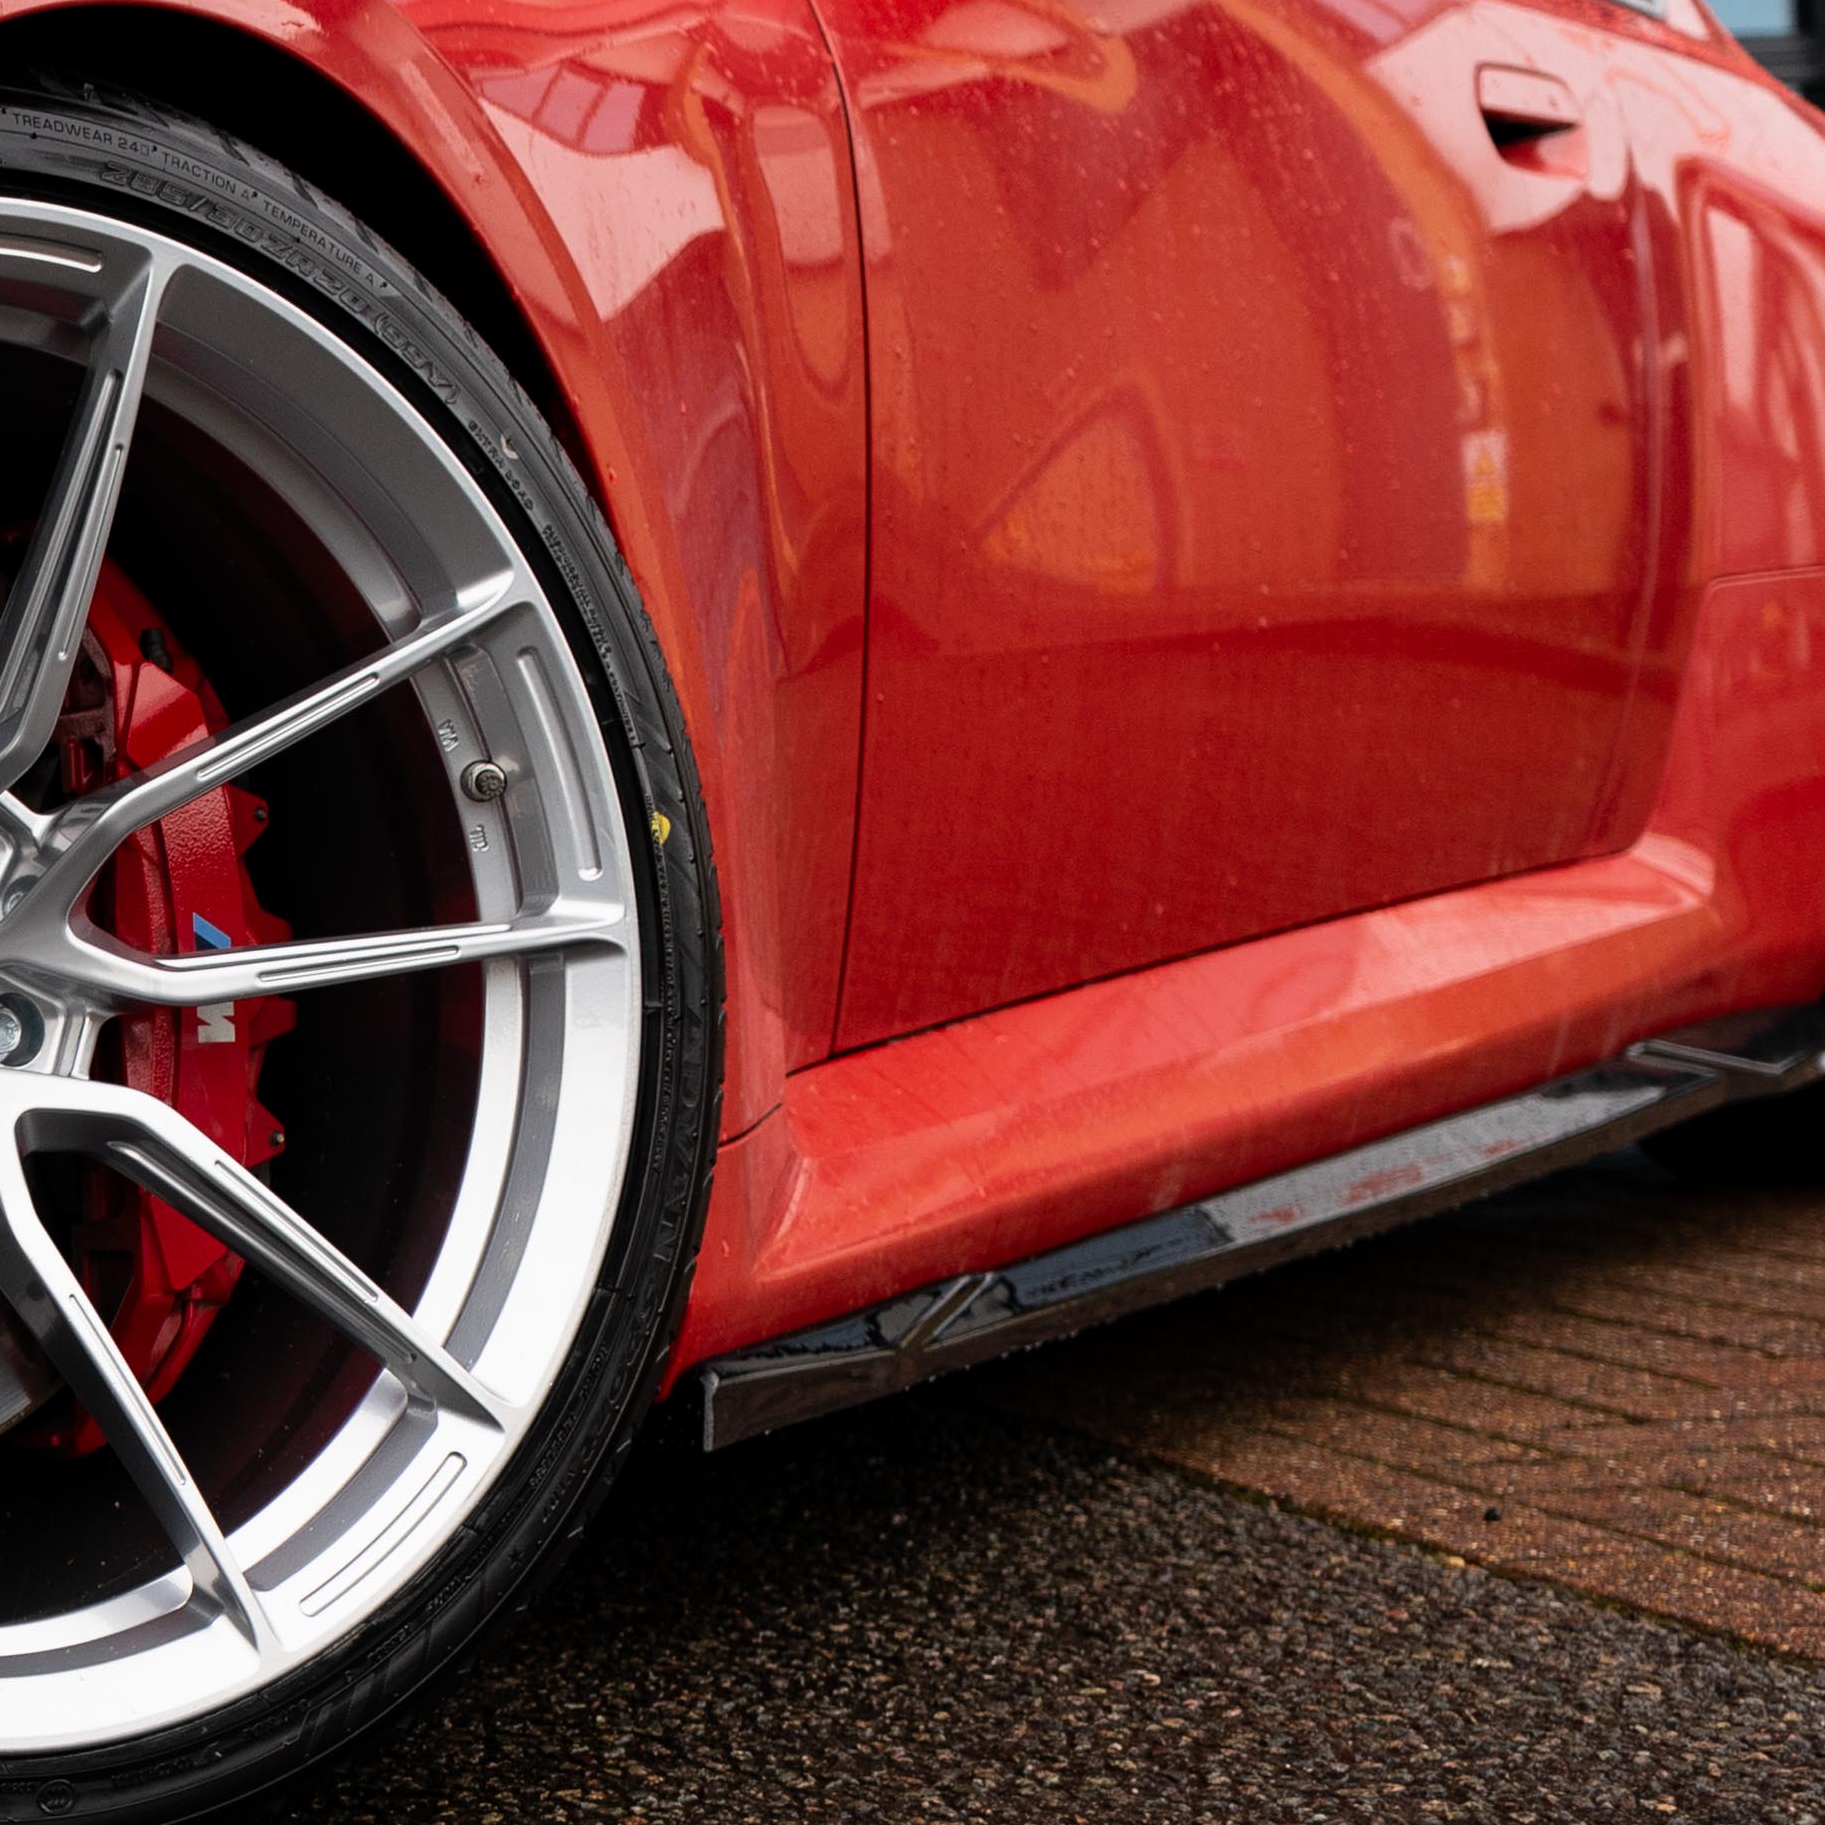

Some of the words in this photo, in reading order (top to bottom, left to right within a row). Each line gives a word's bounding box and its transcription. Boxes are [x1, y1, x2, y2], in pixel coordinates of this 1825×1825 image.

[11, 110, 114, 148] TREADWEAR
[160, 150, 237, 194] TRACTION
[260, 199, 363, 275] TEMPERATURE
[651, 1005, 702, 1264] ADVAN
